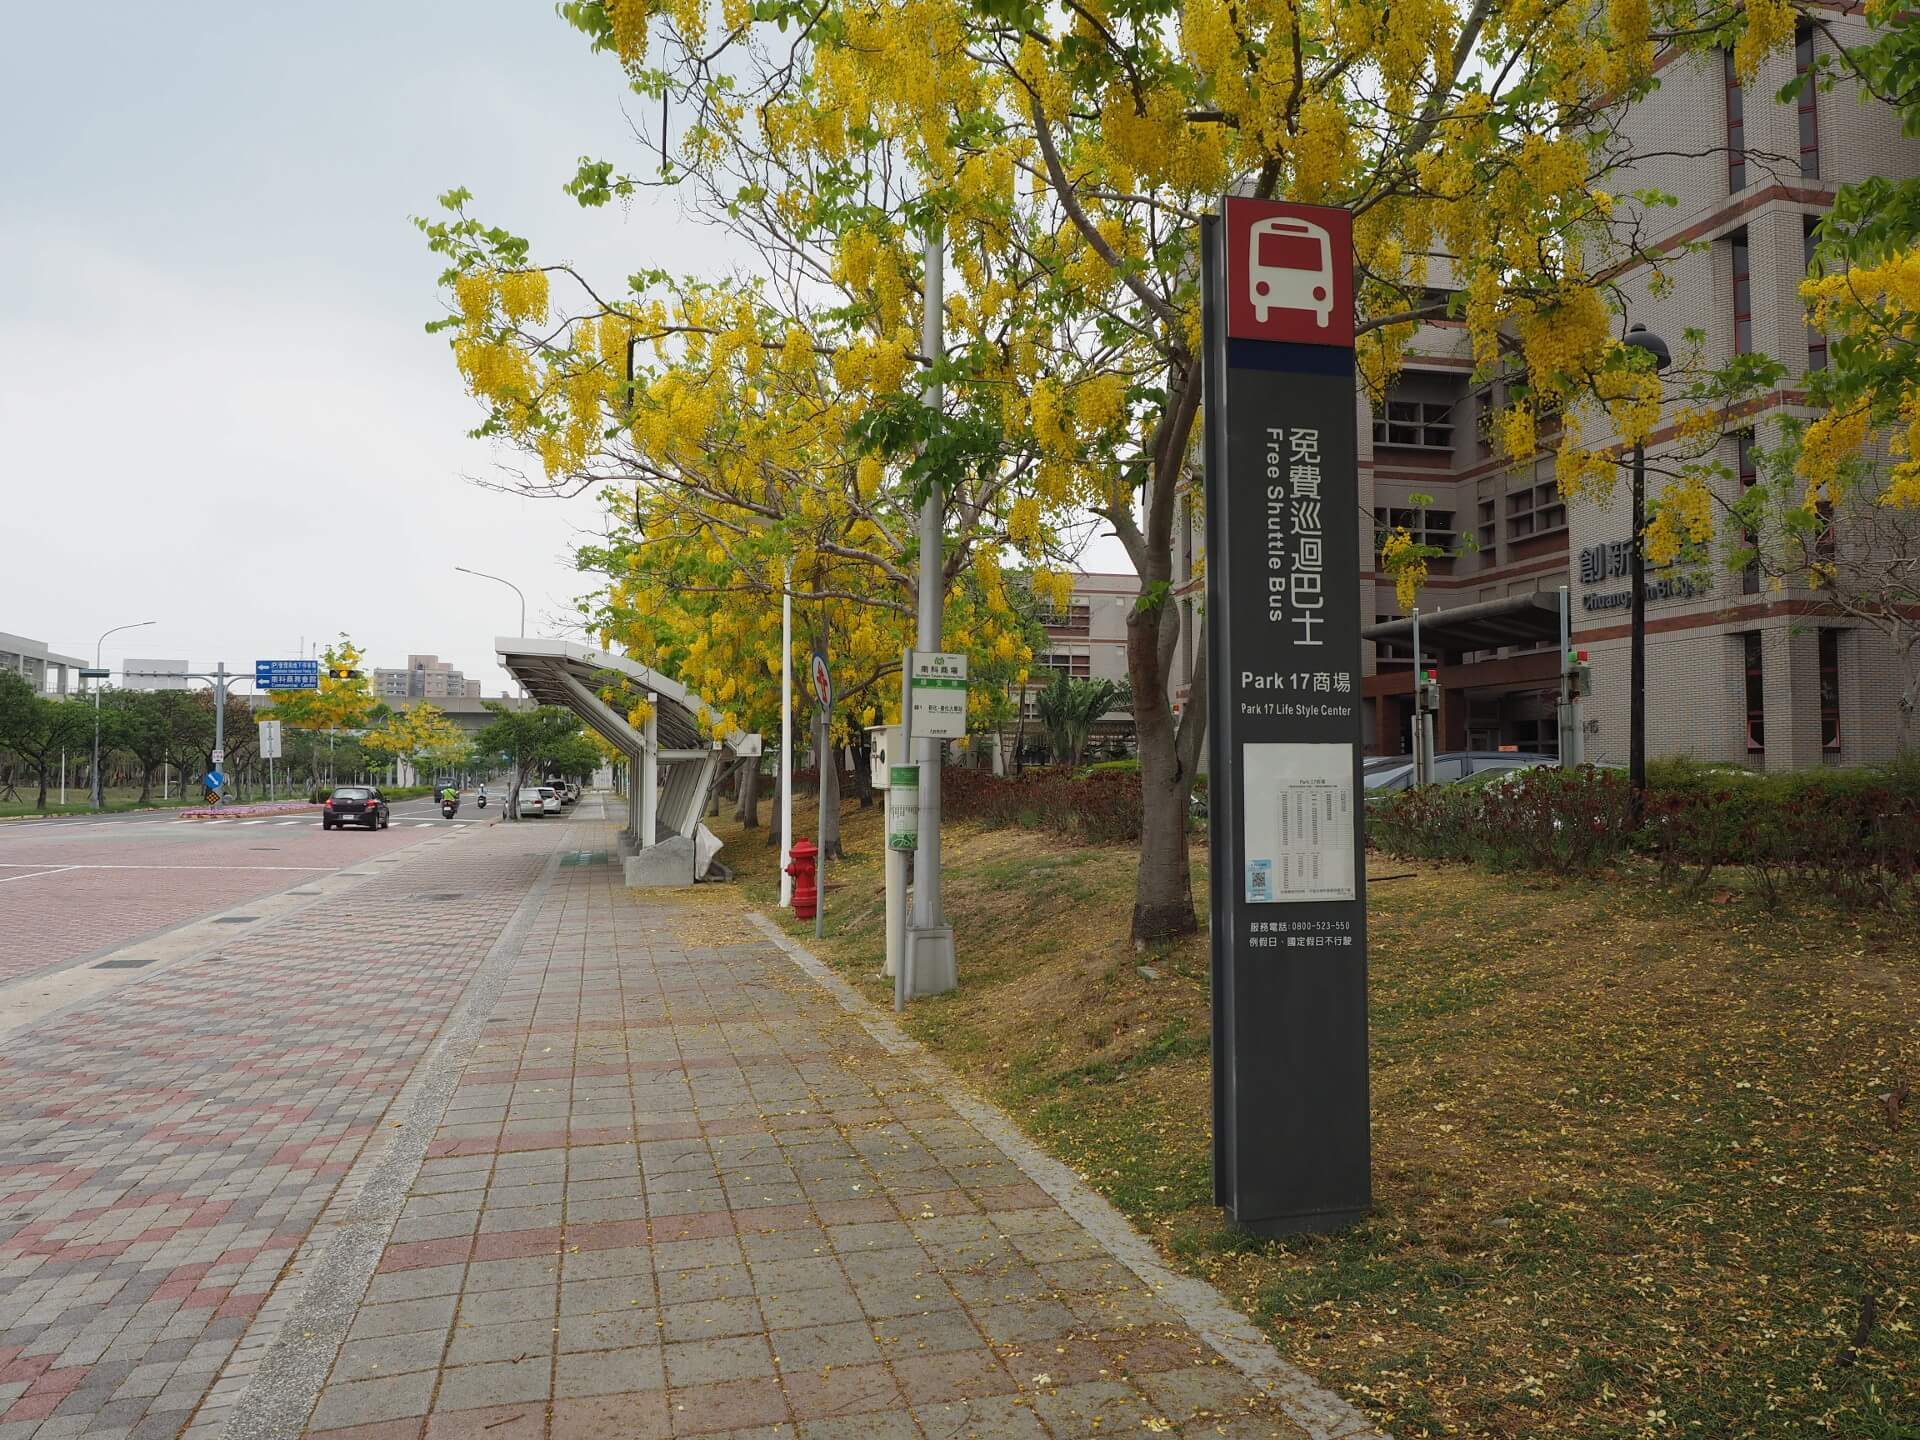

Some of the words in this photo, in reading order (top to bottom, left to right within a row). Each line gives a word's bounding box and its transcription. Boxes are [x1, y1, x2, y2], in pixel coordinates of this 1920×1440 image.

[1266, 428, 1284, 478] Free
[1267, 485, 1285, 570] Shuttle
[1289, 427, 1324, 646] 免費巡迴巴士
[1268, 577, 1286, 622] Bus
[1241, 671, 1285, 689] Park
[1289, 672, 1351, 693] 17商場
[1241, 703, 1261, 715] Park
[1264, 703, 1274, 714] 17
[1276, 703, 1294, 715] Life
[1296, 704, 1319, 718] Style
[1320, 705, 1351, 716] Center
